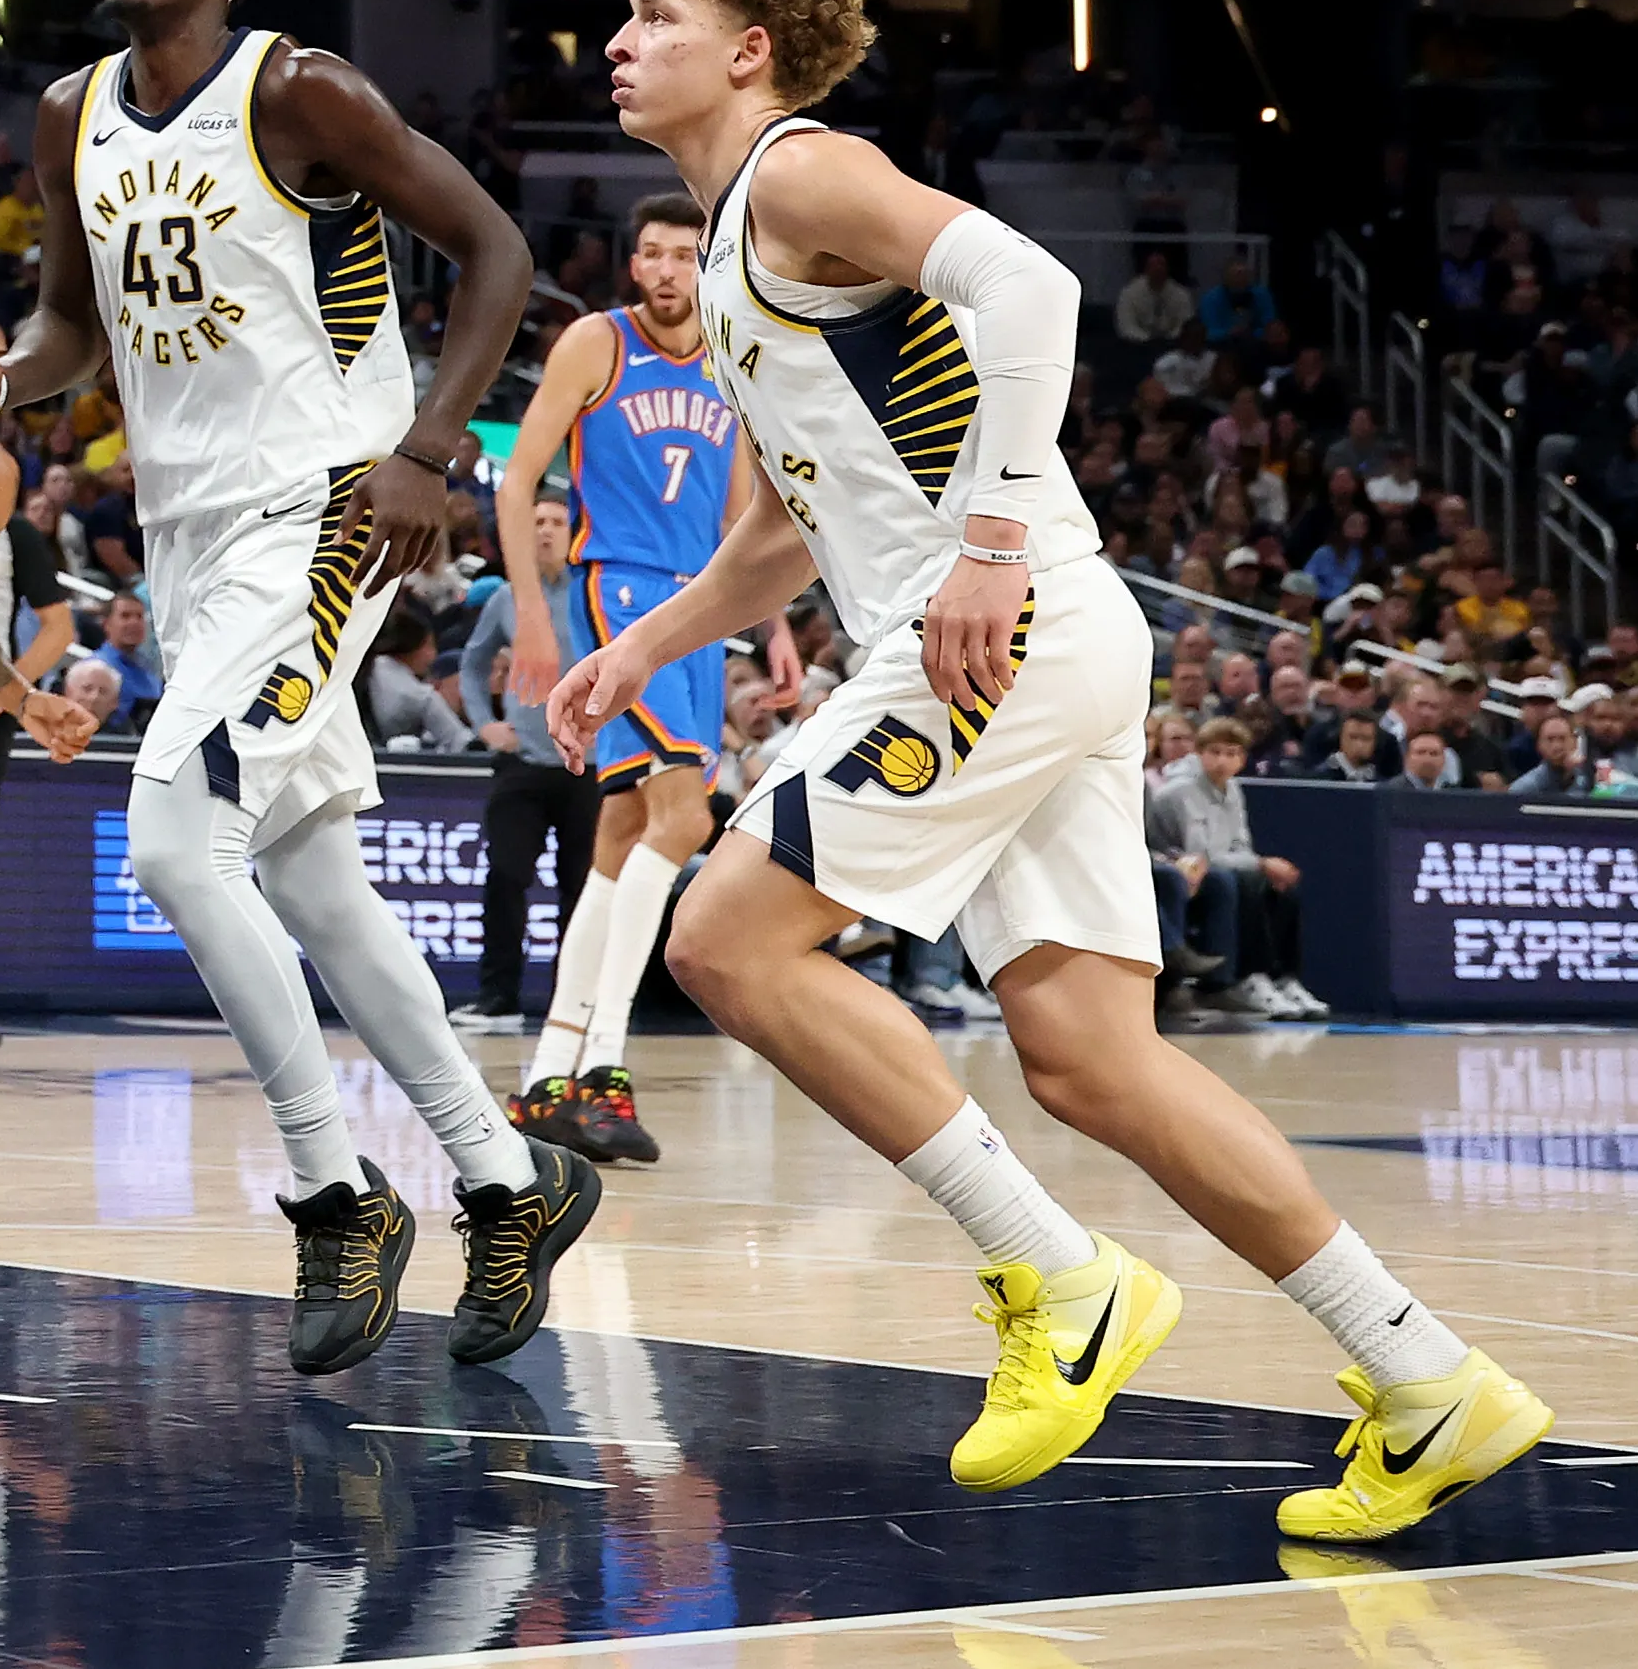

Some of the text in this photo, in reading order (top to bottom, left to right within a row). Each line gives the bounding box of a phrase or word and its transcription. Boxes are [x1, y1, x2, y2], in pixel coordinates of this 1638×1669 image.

[187, 118, 223, 130] LUCAS
[89, 159, 239, 244] INDIANA
[122, 215, 207, 309] 43
[117, 293, 246, 367] PACERS
[616, 386, 735, 449] THUNDER
[661, 442, 694, 505] 7
[1412, 841, 1638, 909] AMERICA
